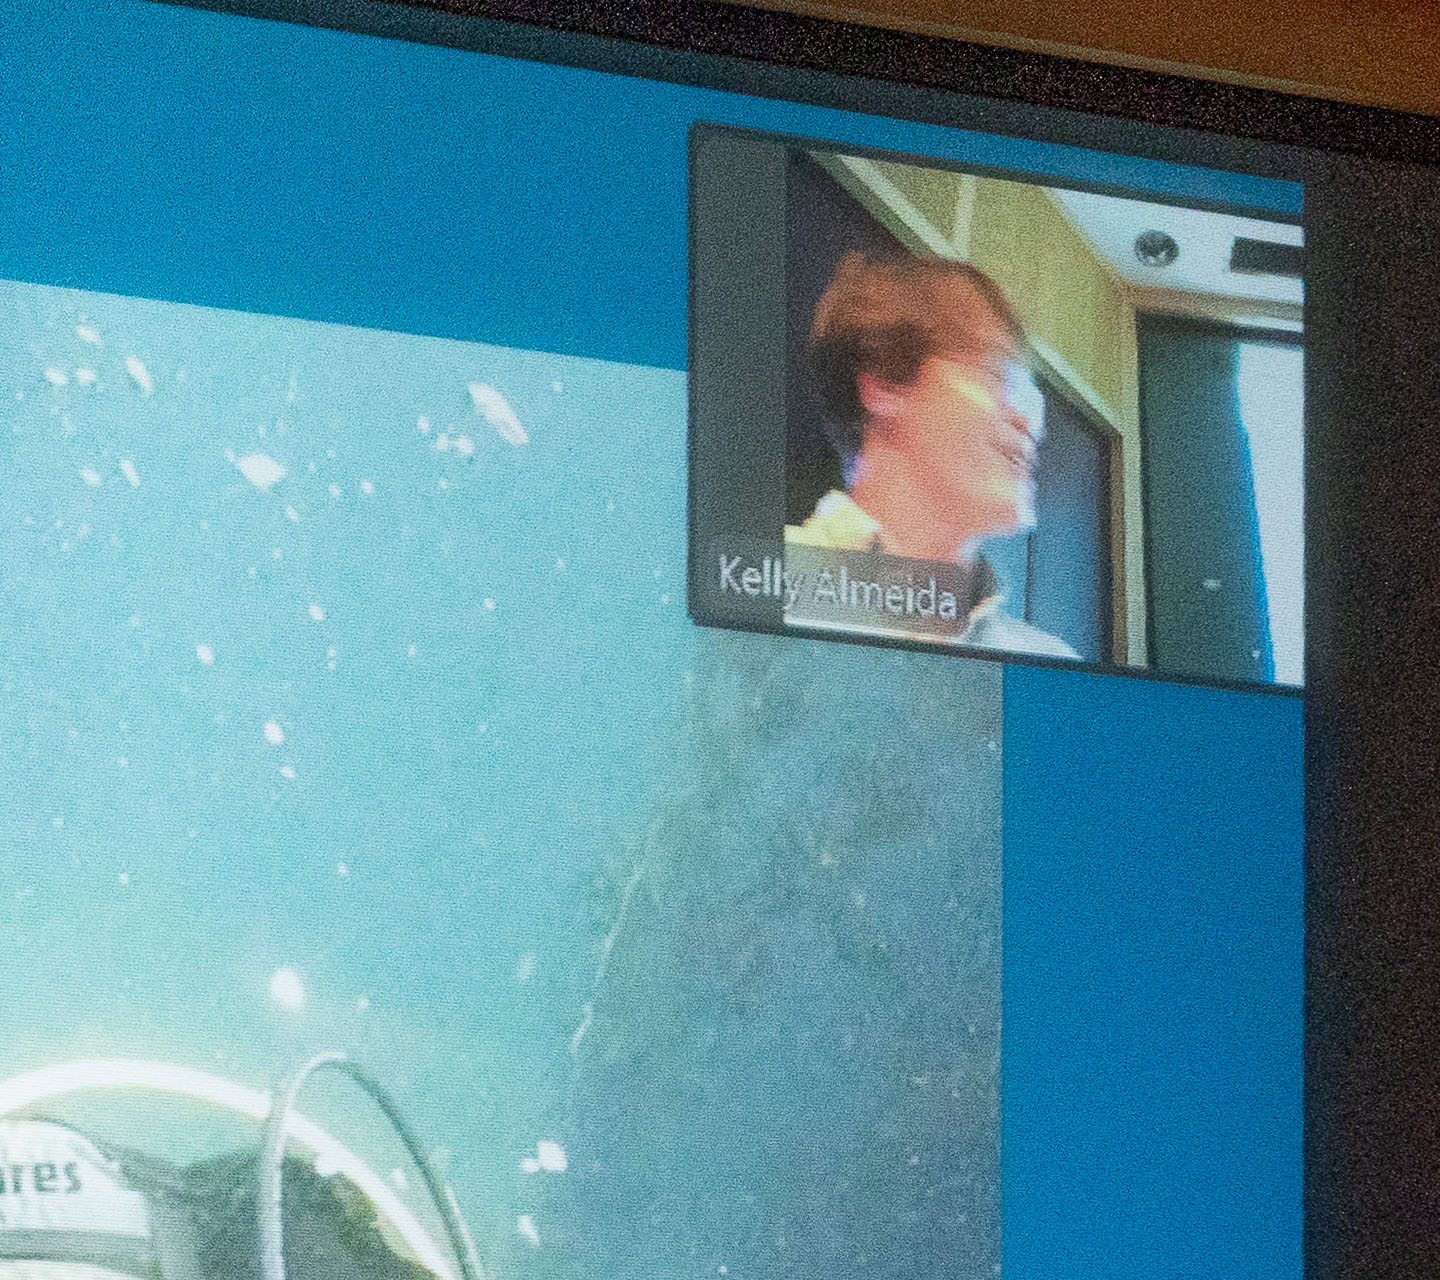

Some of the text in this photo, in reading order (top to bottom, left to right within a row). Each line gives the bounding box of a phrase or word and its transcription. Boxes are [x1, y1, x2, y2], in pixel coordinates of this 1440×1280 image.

[719, 553, 958, 620] Kelly Almeida
[0, 1161, 81, 1193] res
